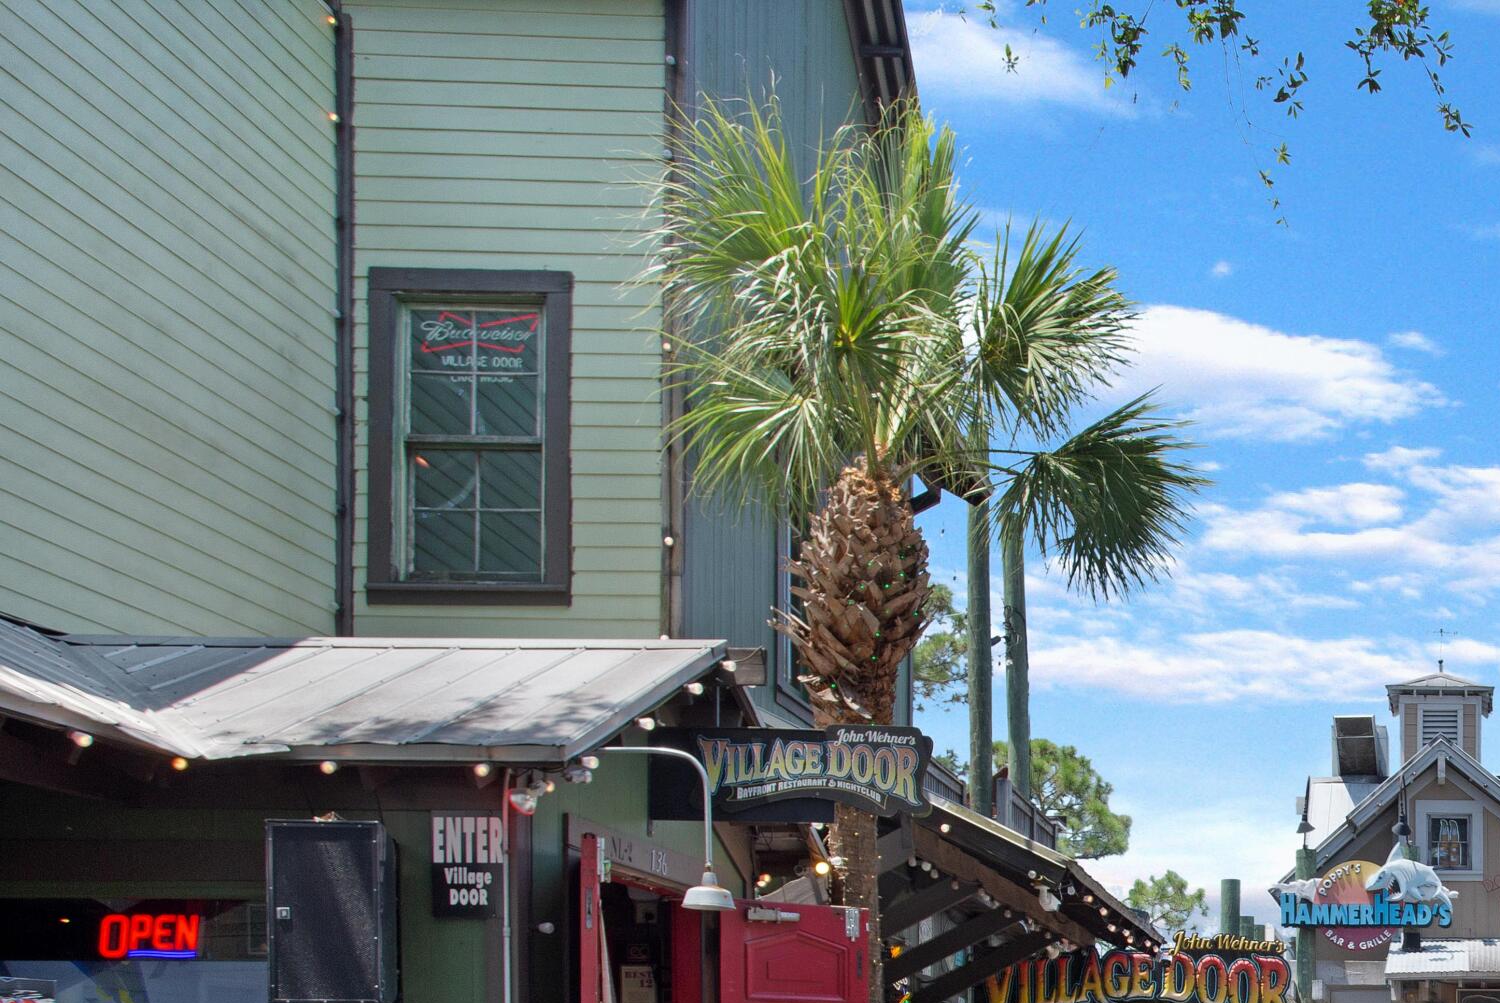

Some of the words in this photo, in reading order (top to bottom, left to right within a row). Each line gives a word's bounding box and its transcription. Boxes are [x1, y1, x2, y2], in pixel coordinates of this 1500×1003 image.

[492, 357, 523, 368] DOOR
[833, 728, 866, 747] John
[865, 730, 917, 746] Wehner's
[697, 737, 826, 796] VILLAGE
[826, 740, 923, 807] DOOR
[736, 781, 777, 800] BAYFRONT
[778, 778, 828, 789] RESTAURANT
[829, 779, 836, 788] &
[837, 781, 882, 803] NIGHTCLUB
[433, 816, 504, 864] ENTER
[650, 848, 669, 876] 136
[443, 866, 492, 889] Village
[1318, 863, 1361, 896] POPPY'S
[449, 888, 489, 906] DOOR
[99, 914, 200, 960] OPEN
[1168, 930, 1213, 955] John
[1213, 932, 1288, 955] Wehner's
[1325, 929, 1344, 946] BAR
[1348, 941, 1355, 950] &
[1359, 929, 1392, 950] GRILLE
